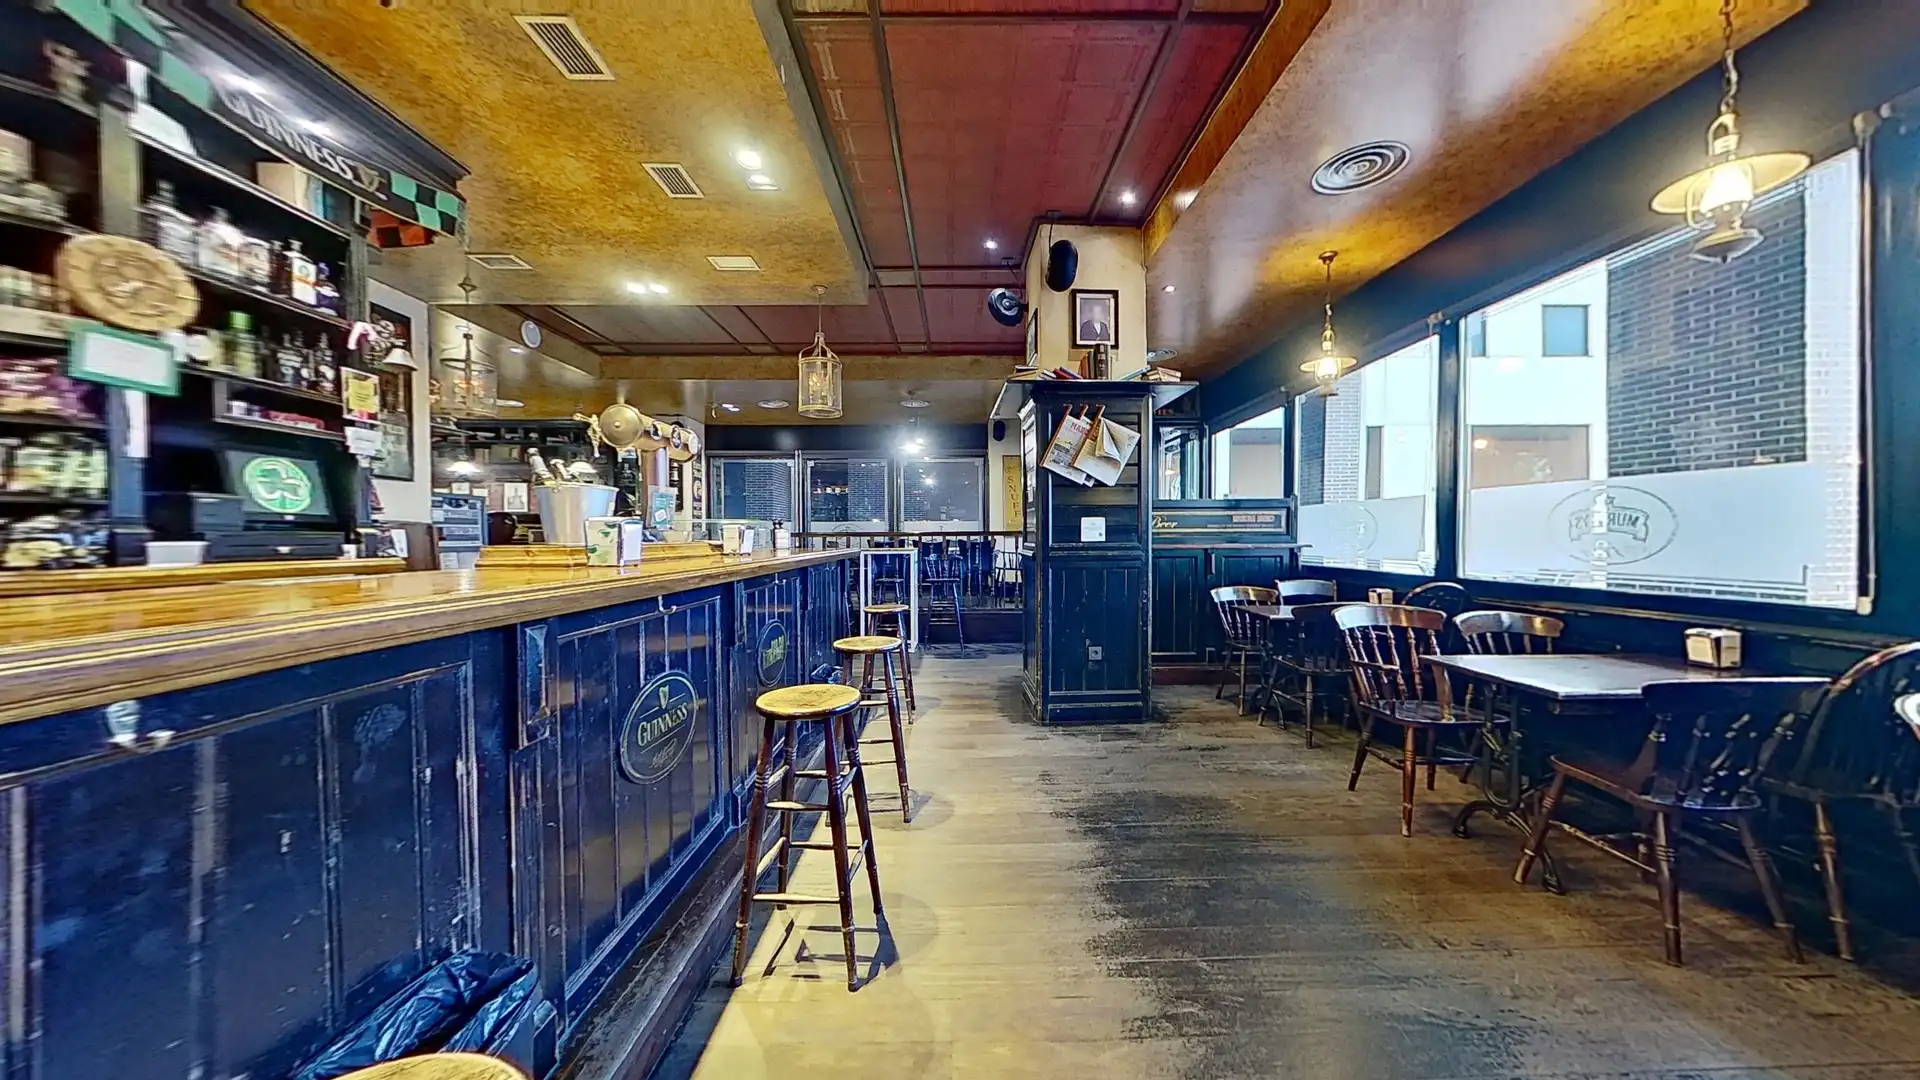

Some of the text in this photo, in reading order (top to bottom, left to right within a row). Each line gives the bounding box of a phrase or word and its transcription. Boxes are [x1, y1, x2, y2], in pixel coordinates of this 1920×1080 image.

[221, 89, 353, 180] GUINNESS
[1152, 515, 1178, 528] Beer
[637, 702, 689, 747] GUINNESS
